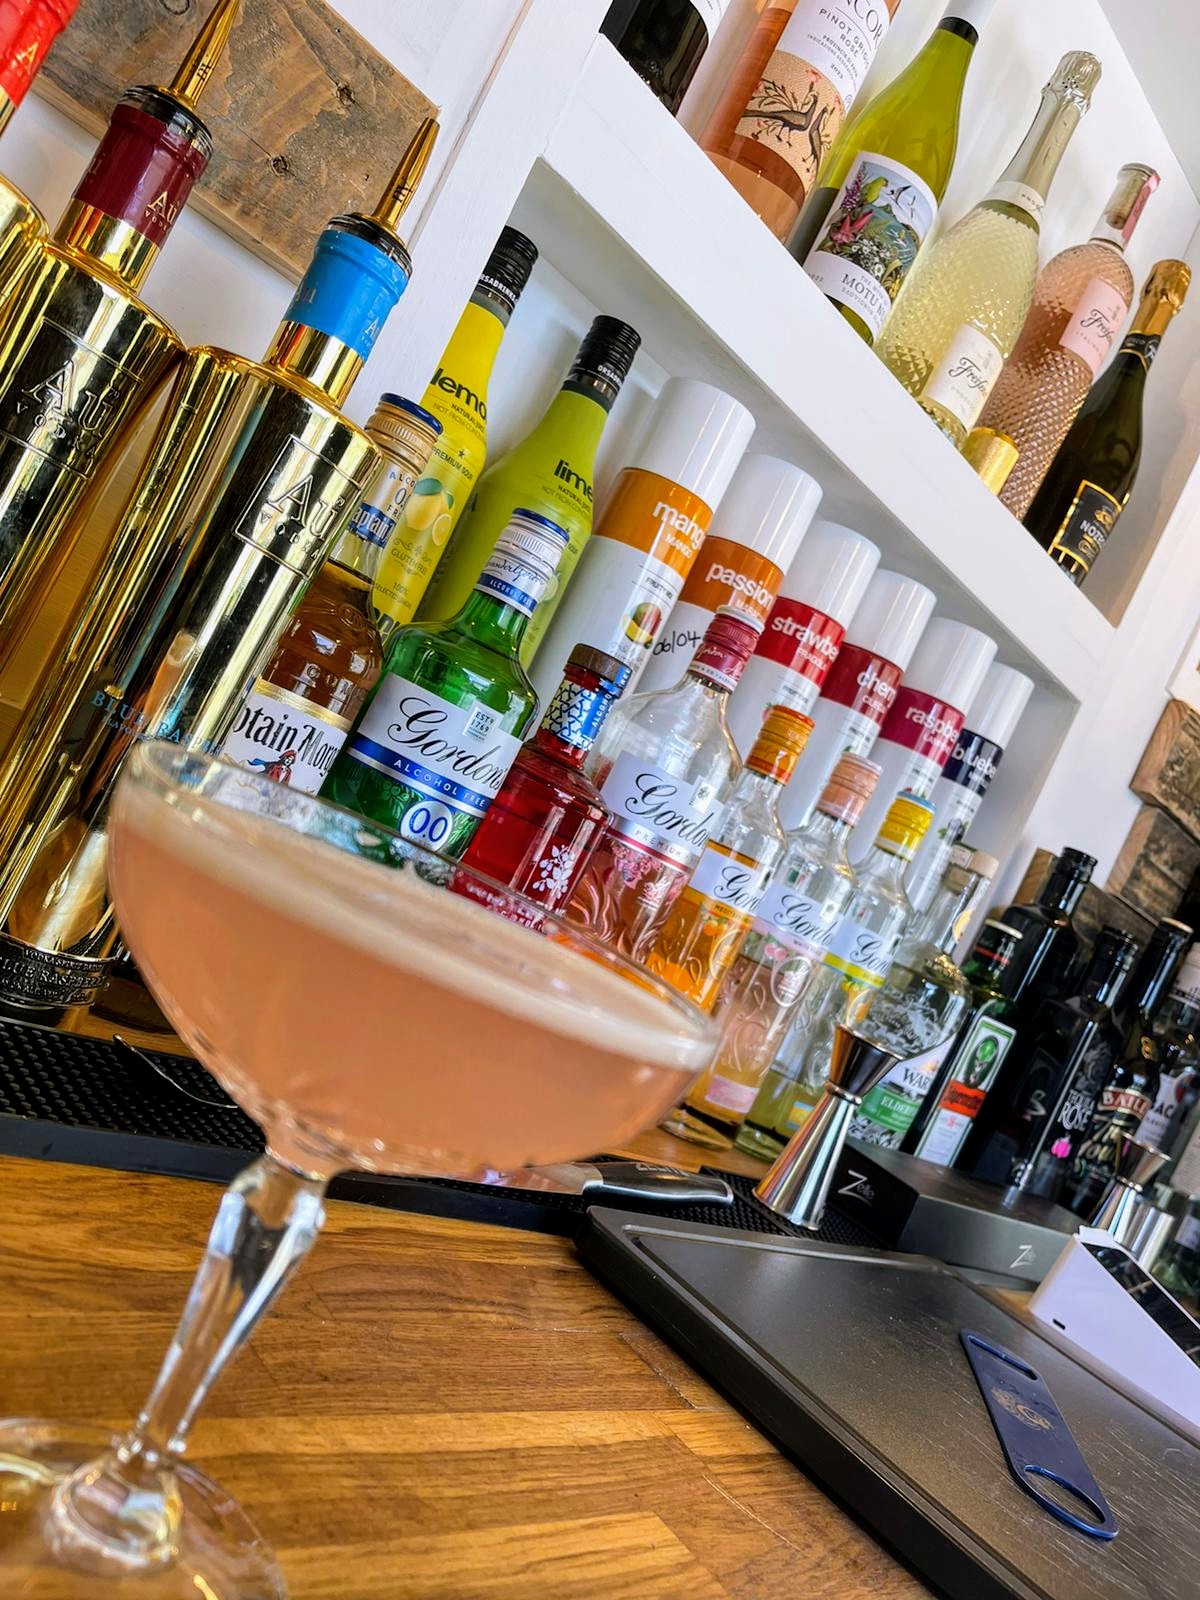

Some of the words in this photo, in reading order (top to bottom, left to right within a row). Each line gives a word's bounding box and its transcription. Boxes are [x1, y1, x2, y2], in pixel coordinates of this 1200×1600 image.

[819, 8, 852, 35] PINOT
[704, 562, 773, 612] passion
[394, 759, 458, 796] ALCOHOL
[463, 793, 486, 807] FREE
[408, 808, 448, 842] 0.0
